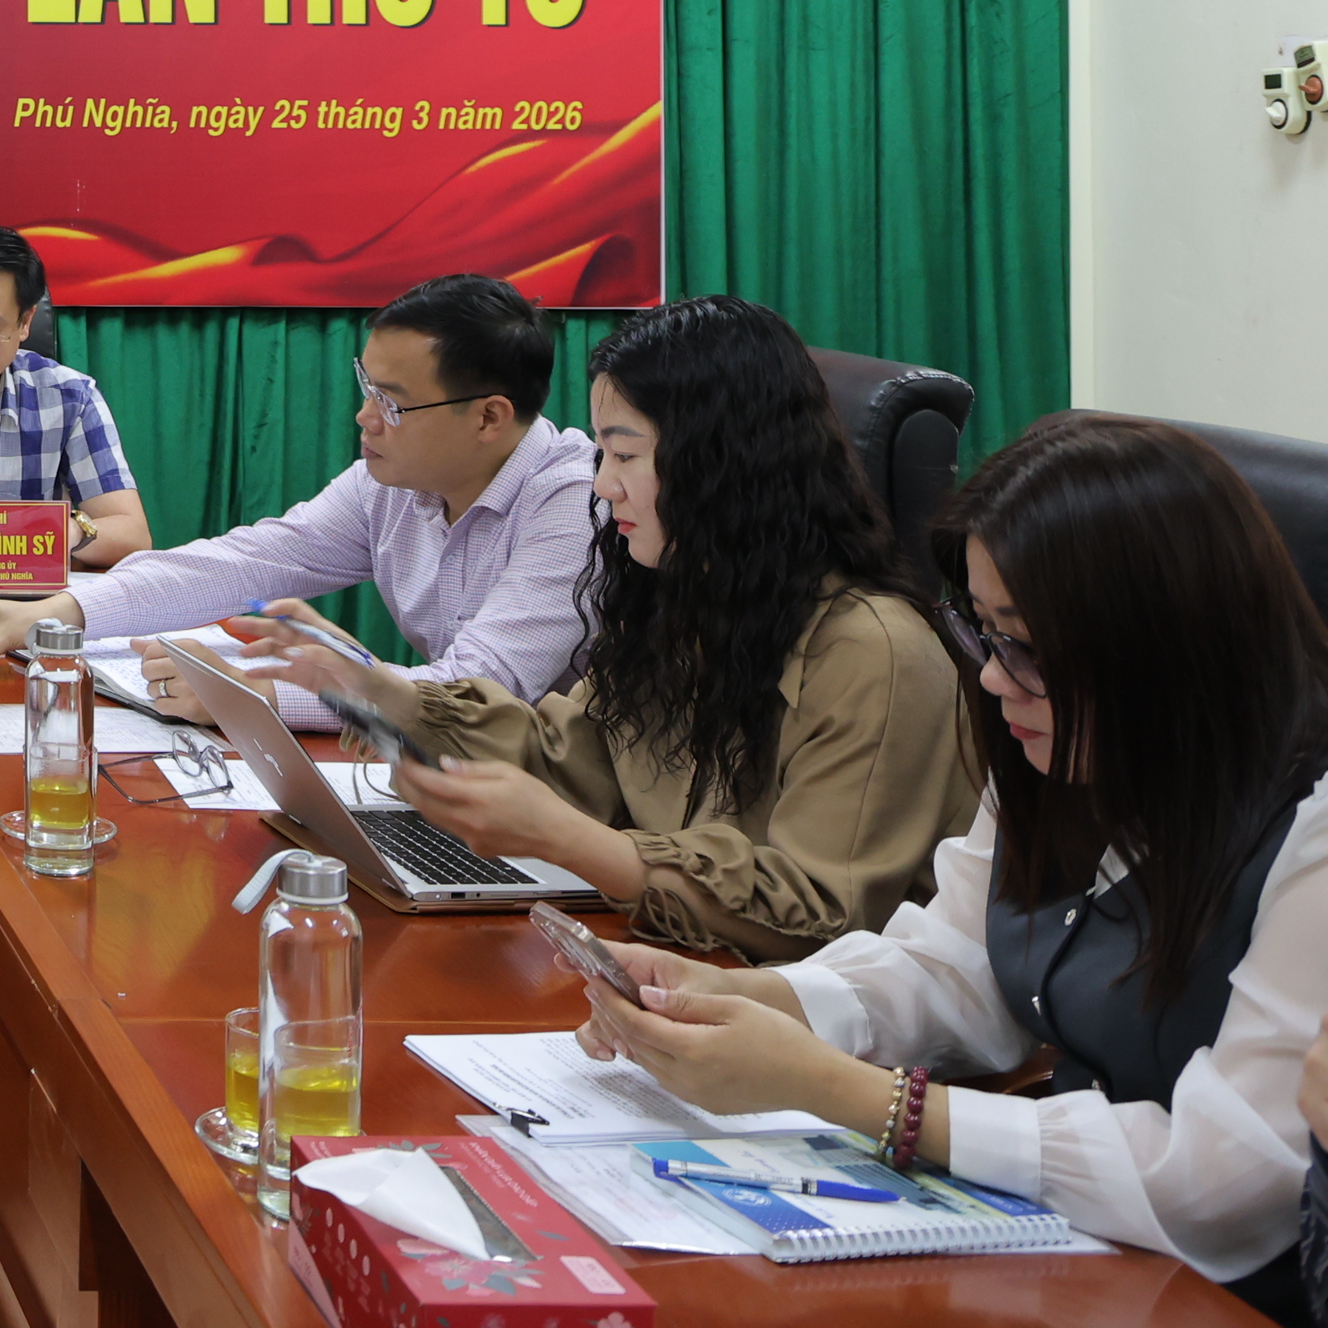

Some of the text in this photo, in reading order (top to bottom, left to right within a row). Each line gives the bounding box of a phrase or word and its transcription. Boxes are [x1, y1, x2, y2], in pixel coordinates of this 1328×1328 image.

[13, 96, 583, 138] Phú Nghĩa, ngày 25 tháng 3 năm 2026
[32, 531, 56, 556] SỸ
[7, 560, 17, 570] ỦY
[11, 572, 34, 581] NGHĨA
